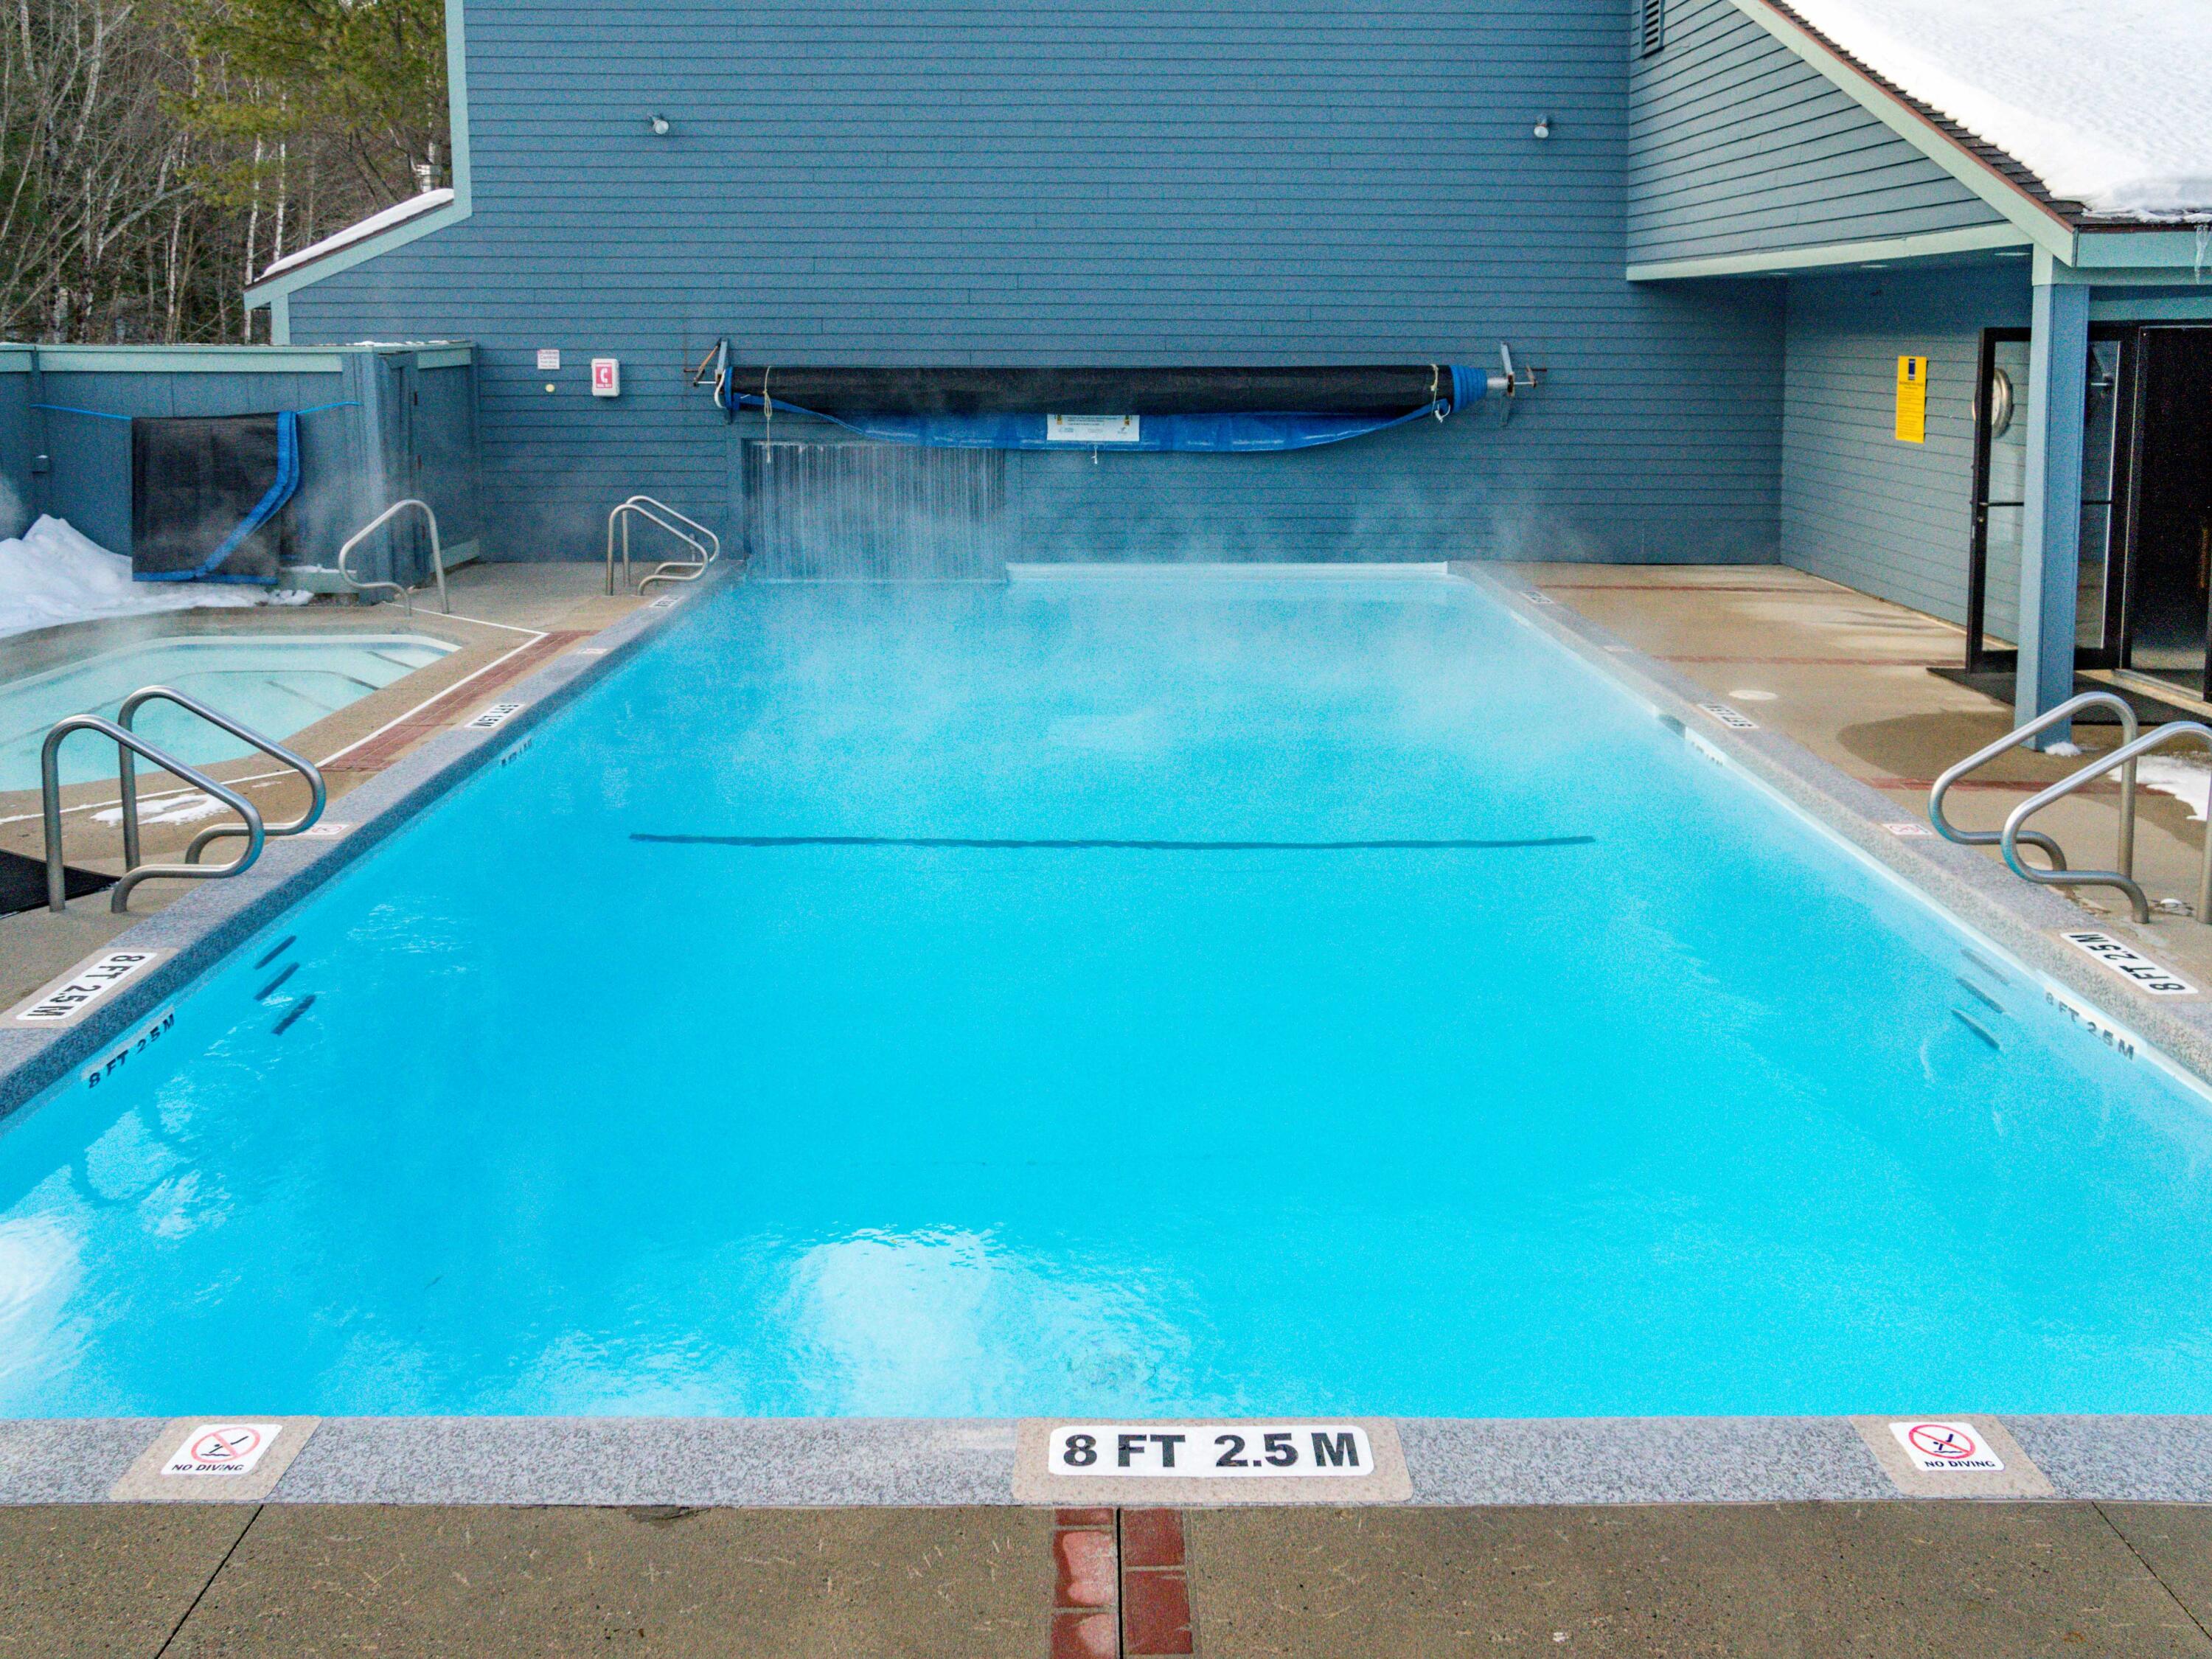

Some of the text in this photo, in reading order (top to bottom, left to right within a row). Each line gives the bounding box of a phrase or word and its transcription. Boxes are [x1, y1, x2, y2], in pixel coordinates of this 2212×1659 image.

[85, 965, 134, 980] FT
[2068, 933, 2185, 991] 8 FT 2.5 M
[27, 1005, 74, 1016] M
[49, 984, 102, 1003] 2.5
[2045, 992, 2054, 1006] 8
[2058, 1001, 2079, 1023] FT
[2118, 1038, 2135, 1060] M
[88, 1072, 101, 1088] 8
[106, 1049, 129, 1077] FT
[162, 1013, 175, 1033] M
[1062, 1432, 1360, 1467] 8 FT 2.5 M
